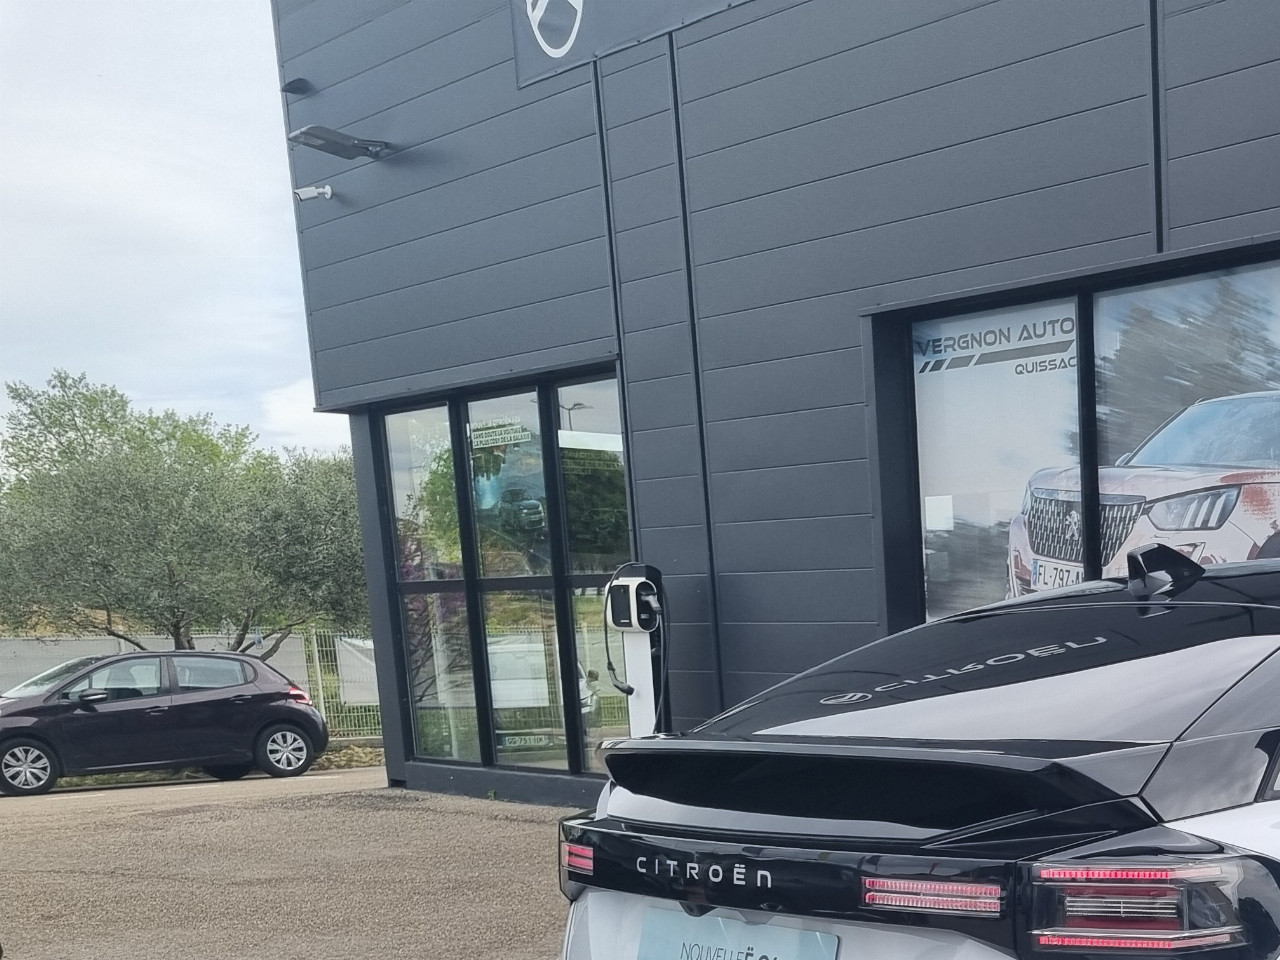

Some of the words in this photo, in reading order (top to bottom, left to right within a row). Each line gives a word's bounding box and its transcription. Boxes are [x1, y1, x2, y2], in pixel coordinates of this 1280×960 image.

[915, 327, 1011, 357] VERGNON
[1018, 317, 1075, 342] AUTO
[1015, 355, 1077, 375] QUISSAC
[1038, 565, 1084, 588] FL-797-A
